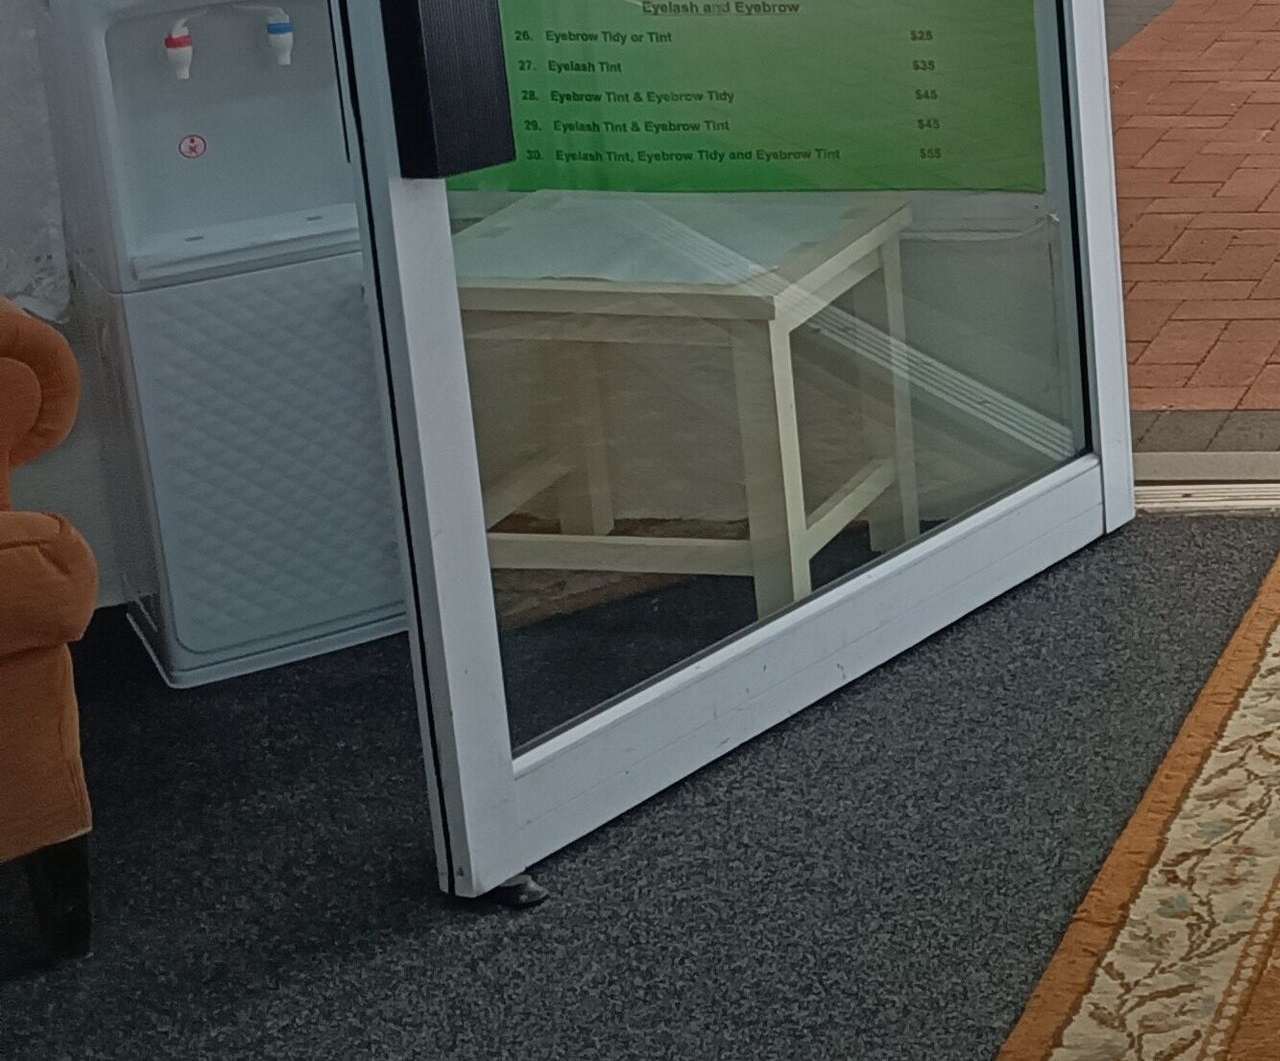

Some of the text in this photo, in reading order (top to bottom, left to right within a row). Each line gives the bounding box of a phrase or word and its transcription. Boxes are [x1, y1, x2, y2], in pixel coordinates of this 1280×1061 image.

[642, 1, 800, 15] Eyelash and Eyebrow
[545, 30, 672, 44] Eyebrow Tidy Tint
[548, 60, 622, 74] Eyelash Tint
[550, 90, 735, 104] Eyebrow Tint Eyebrow Tidy
[553, 119, 729, 133] Eyelash Tint Eyebrow Tint
[555, 148, 840, 163] Eyelash Eyebrow Tidy and Eyebrow Tint
